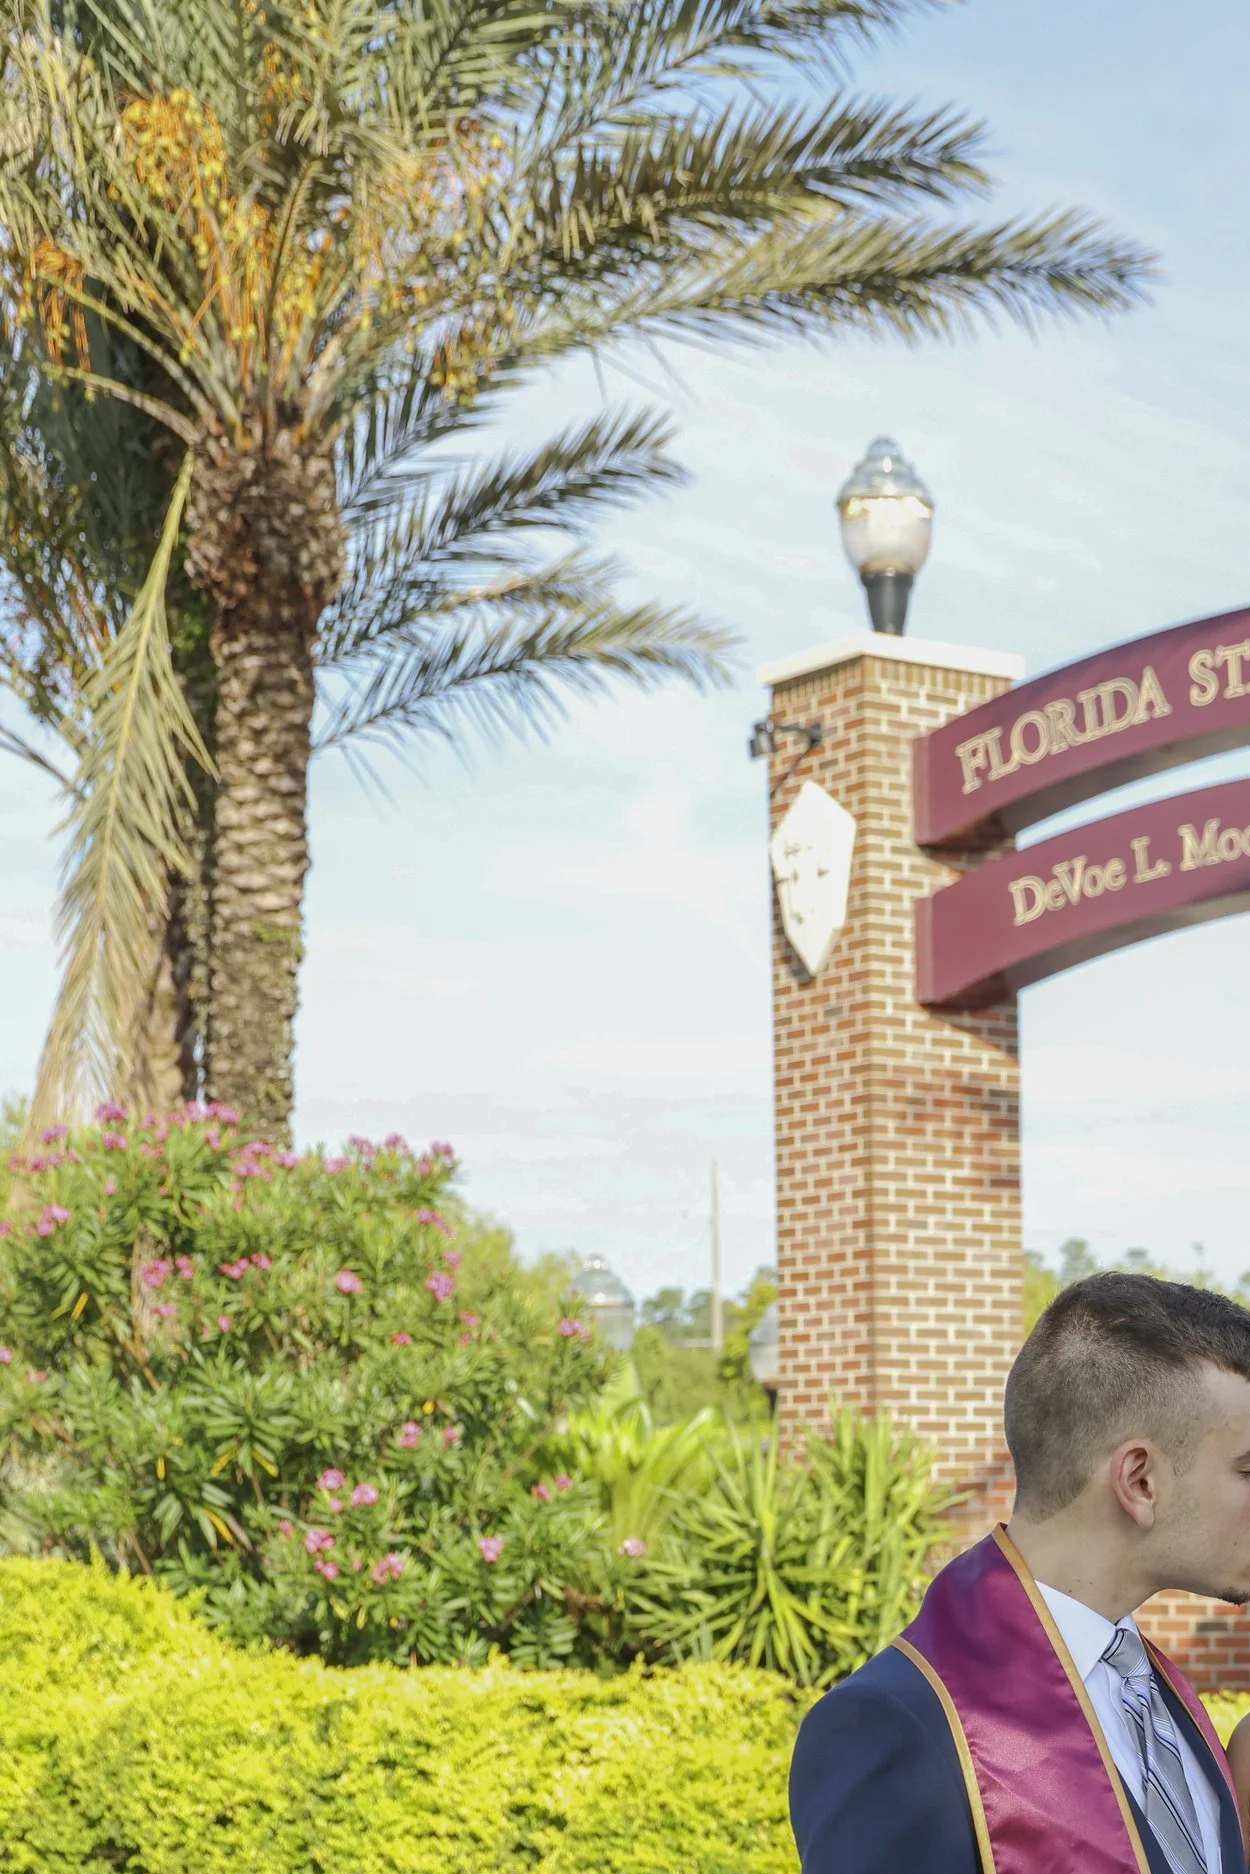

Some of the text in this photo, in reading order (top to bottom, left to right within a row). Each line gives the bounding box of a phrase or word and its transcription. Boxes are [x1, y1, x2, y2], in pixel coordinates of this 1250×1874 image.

[955, 666, 1172, 794] FLORIDA
[1008, 855, 1127, 927] DeVoe
[1130, 836, 1171, 884] L.
